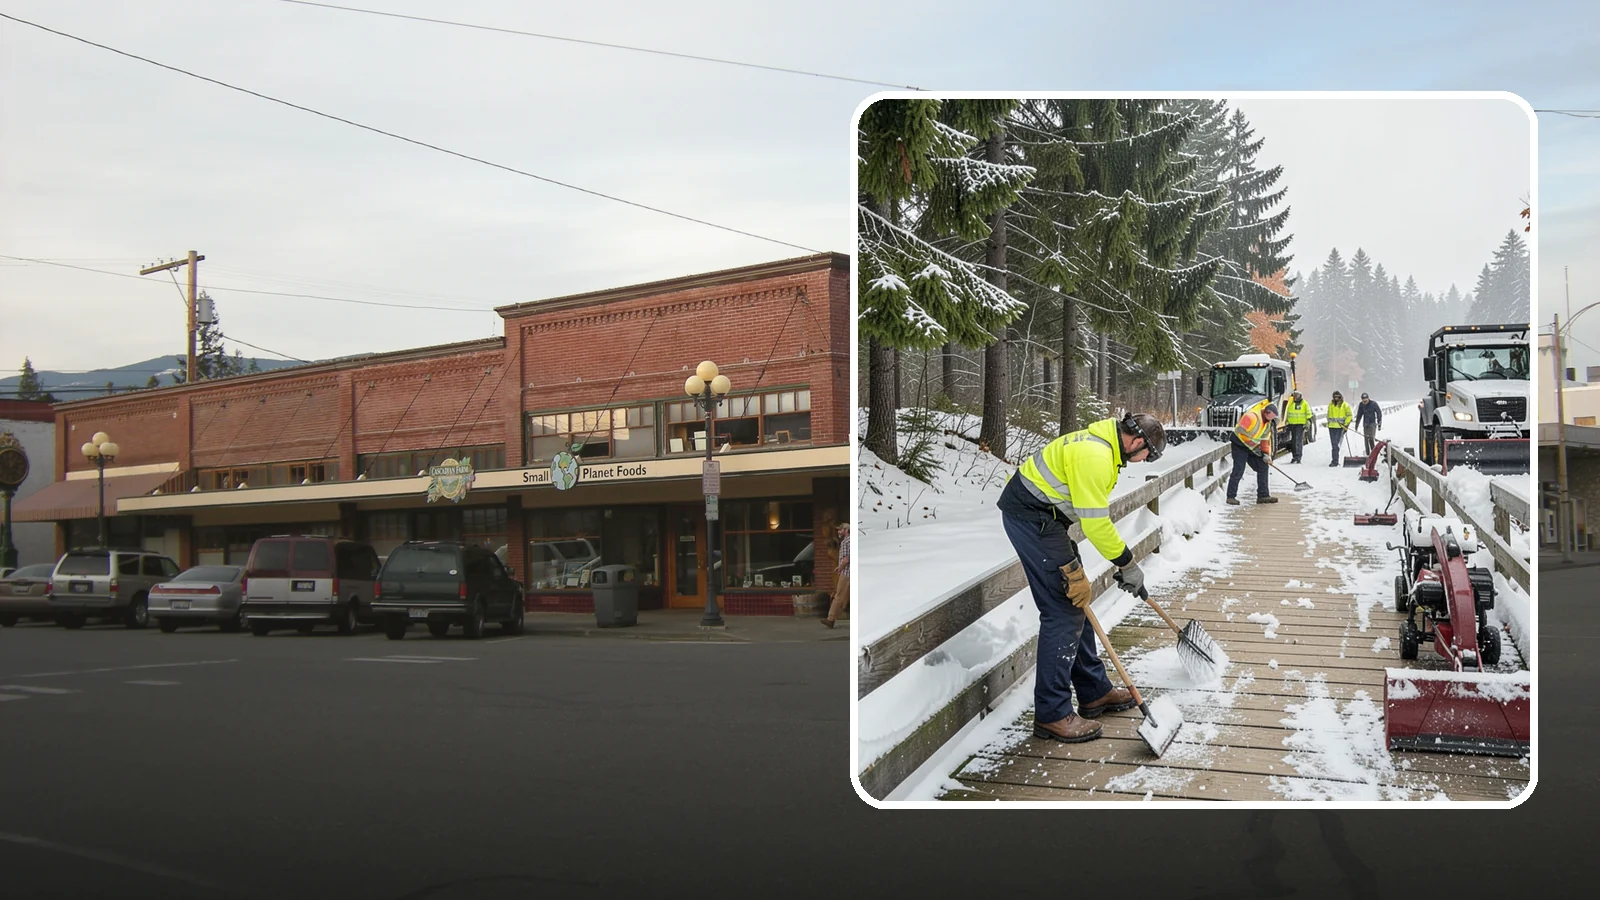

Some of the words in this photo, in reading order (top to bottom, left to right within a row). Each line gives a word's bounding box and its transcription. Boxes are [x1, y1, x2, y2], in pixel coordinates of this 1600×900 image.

[523, 471, 549, 483] Small
[583, 467, 614, 479] Planet
[617, 464, 647, 477] Foods
